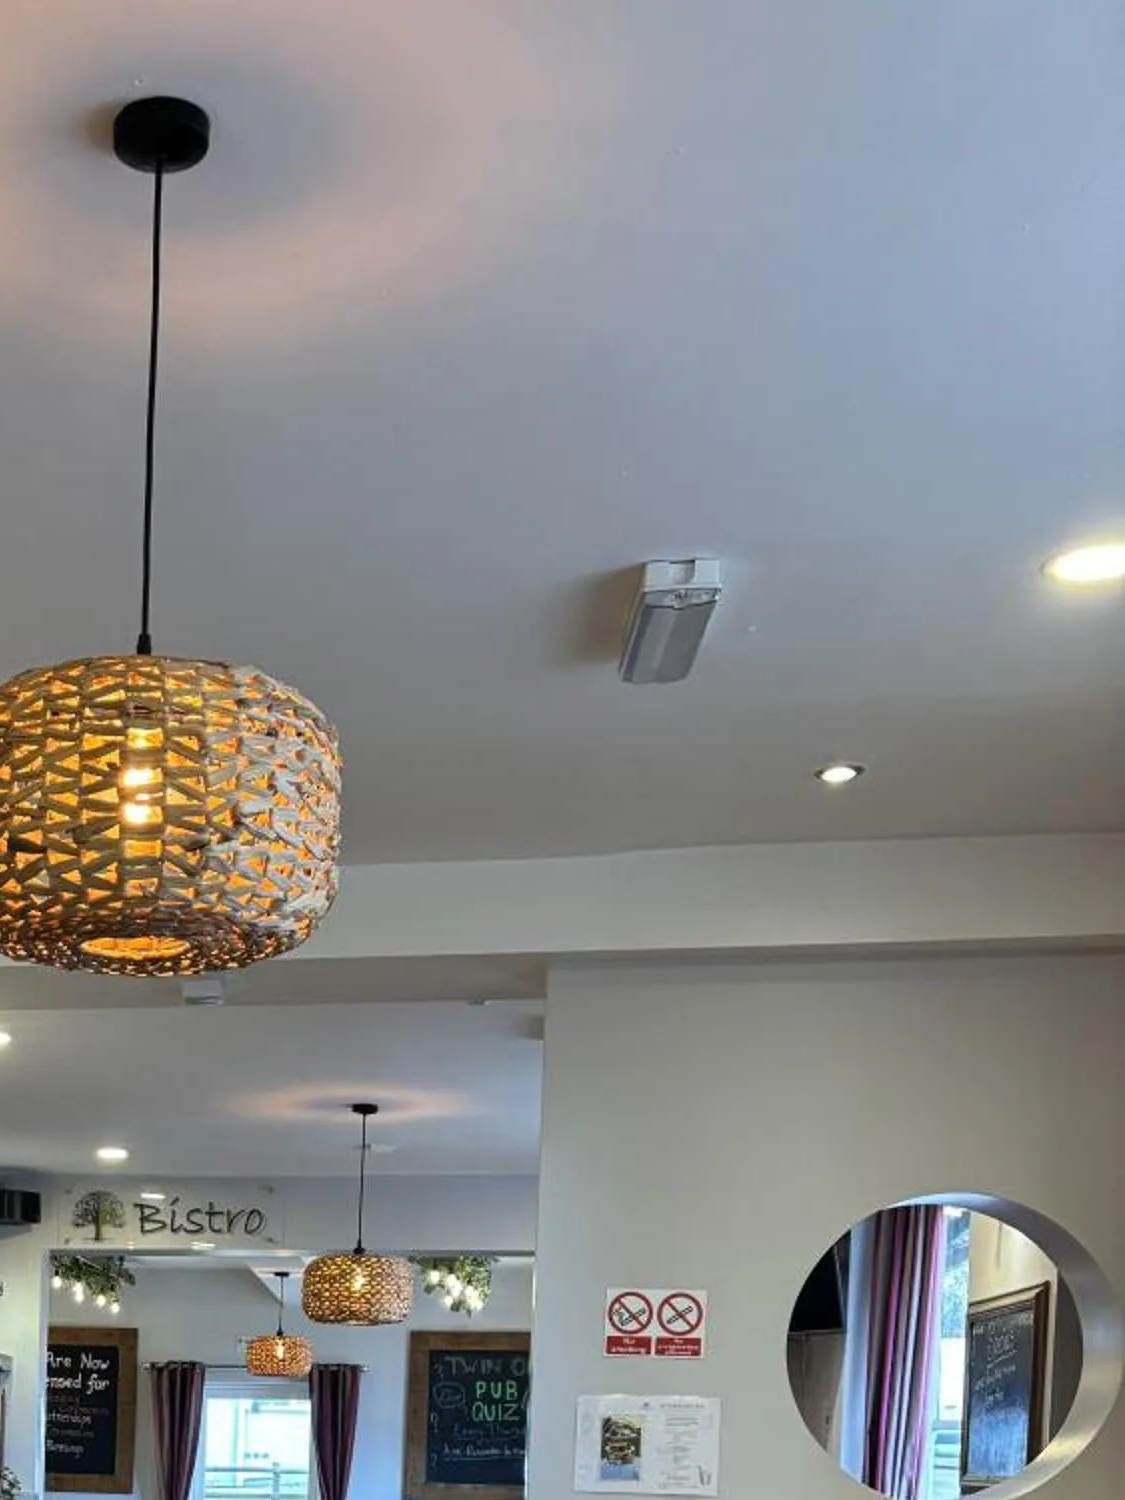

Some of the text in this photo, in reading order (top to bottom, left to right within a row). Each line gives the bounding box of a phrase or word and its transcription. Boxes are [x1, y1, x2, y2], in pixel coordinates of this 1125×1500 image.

[133, 1197, 264, 1236] Bistro
[80, 1352, 111, 1370] Now
[445, 1356, 502, 1376] TWIN
[86, 1373, 111, 1395] for
[474, 1379, 519, 1401] PUB
[471, 1401, 521, 1423] QUIZ
